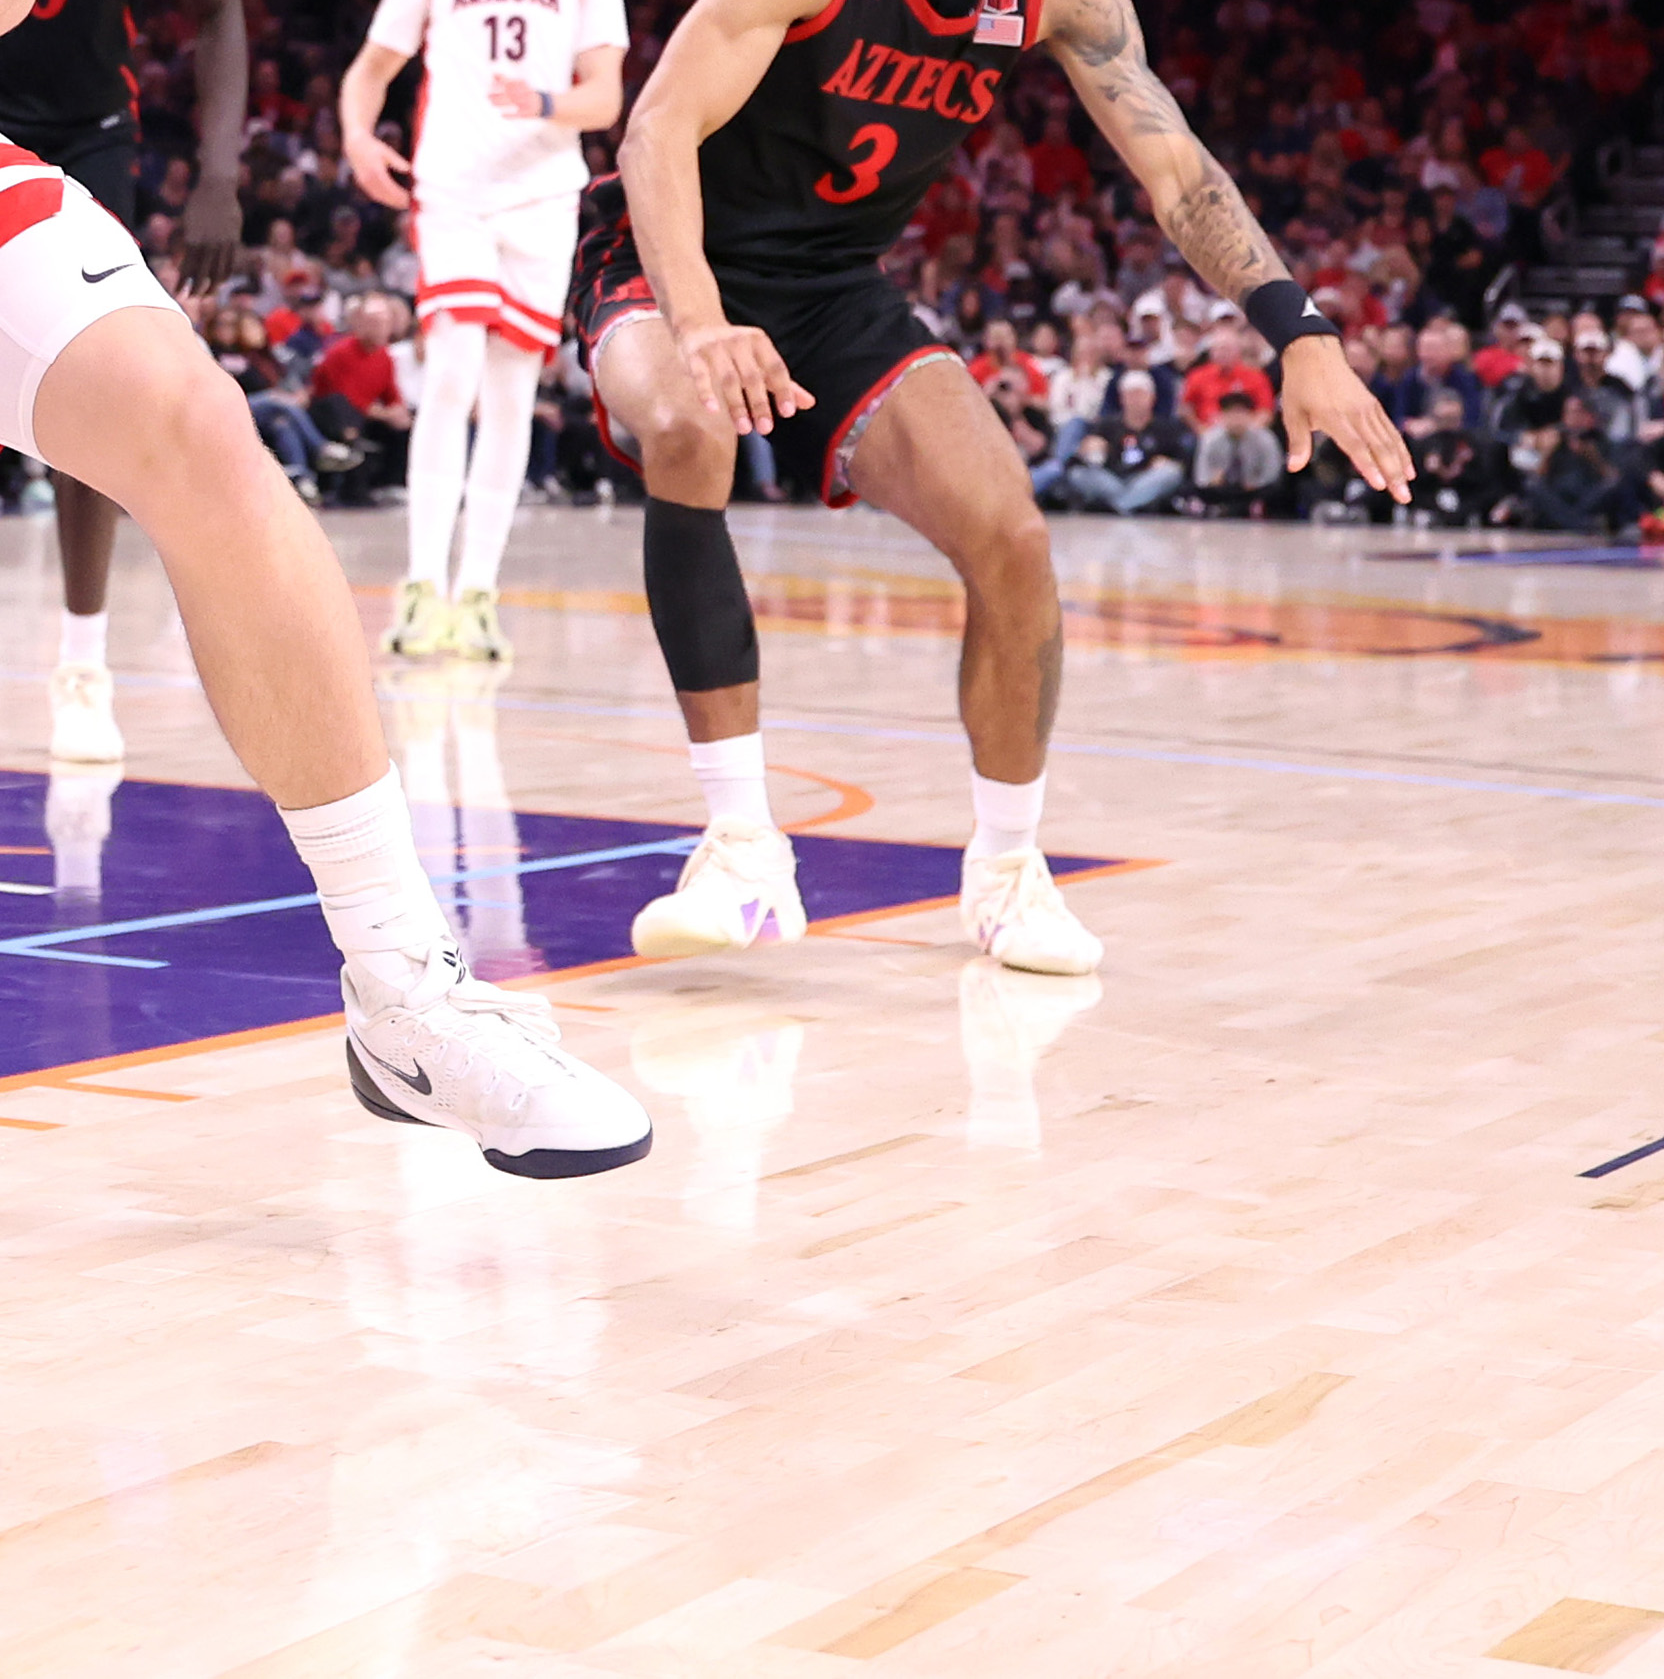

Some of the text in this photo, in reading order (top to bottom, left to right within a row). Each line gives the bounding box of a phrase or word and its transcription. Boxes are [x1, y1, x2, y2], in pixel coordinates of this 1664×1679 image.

[484, 15, 526, 62] 13
[821, 38, 1002, 123] AZTECS
[814, 123, 898, 204] 3
